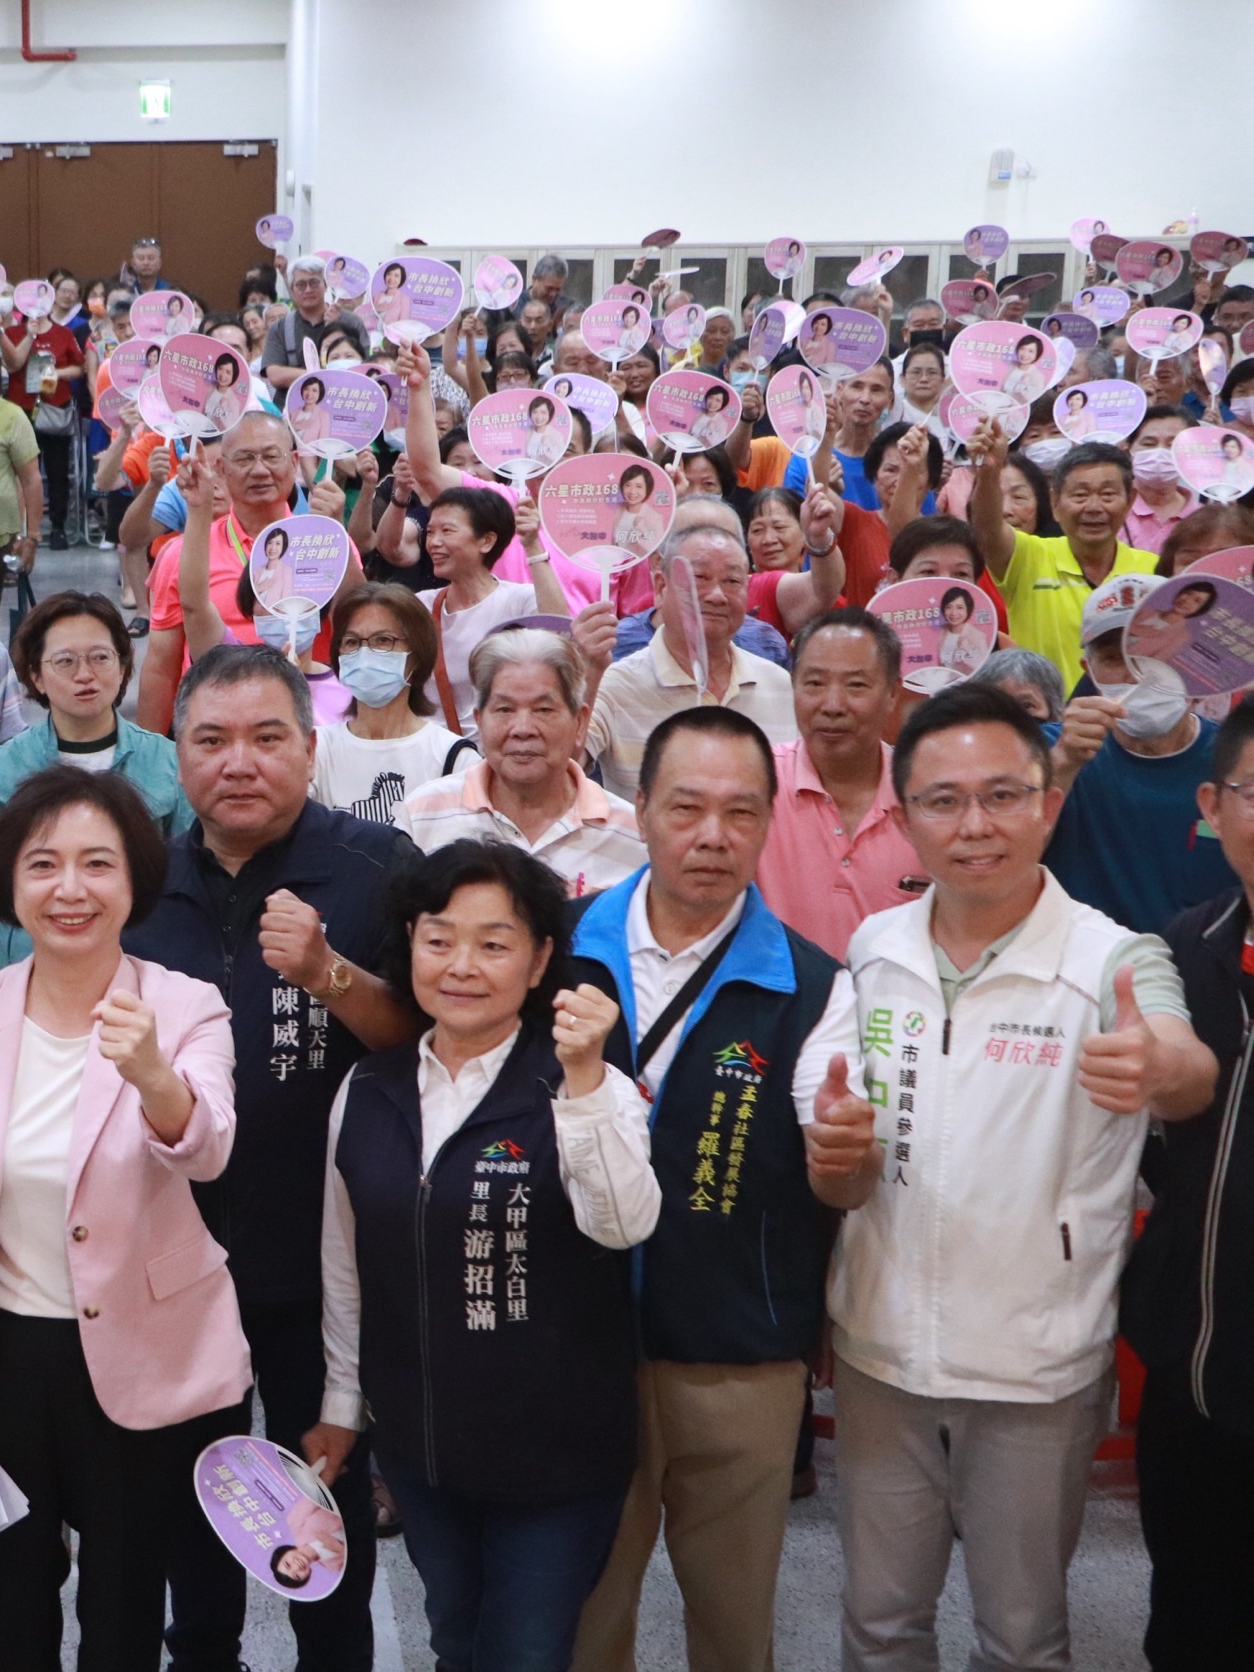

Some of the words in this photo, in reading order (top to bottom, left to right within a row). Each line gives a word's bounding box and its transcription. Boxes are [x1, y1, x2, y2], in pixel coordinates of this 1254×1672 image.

[545, 483, 619, 498] 六星市政168
[877, 607, 941, 623] 星市政168
[270, 987, 299, 1082] 陳威宇
[989, 1022, 1066, 1039] 台中市長候選人
[985, 1036, 1064, 1067] 何欣純
[893, 1044, 920, 1186] 市議員參選人
[505, 1182, 531, 1321] 大甲區太白里
